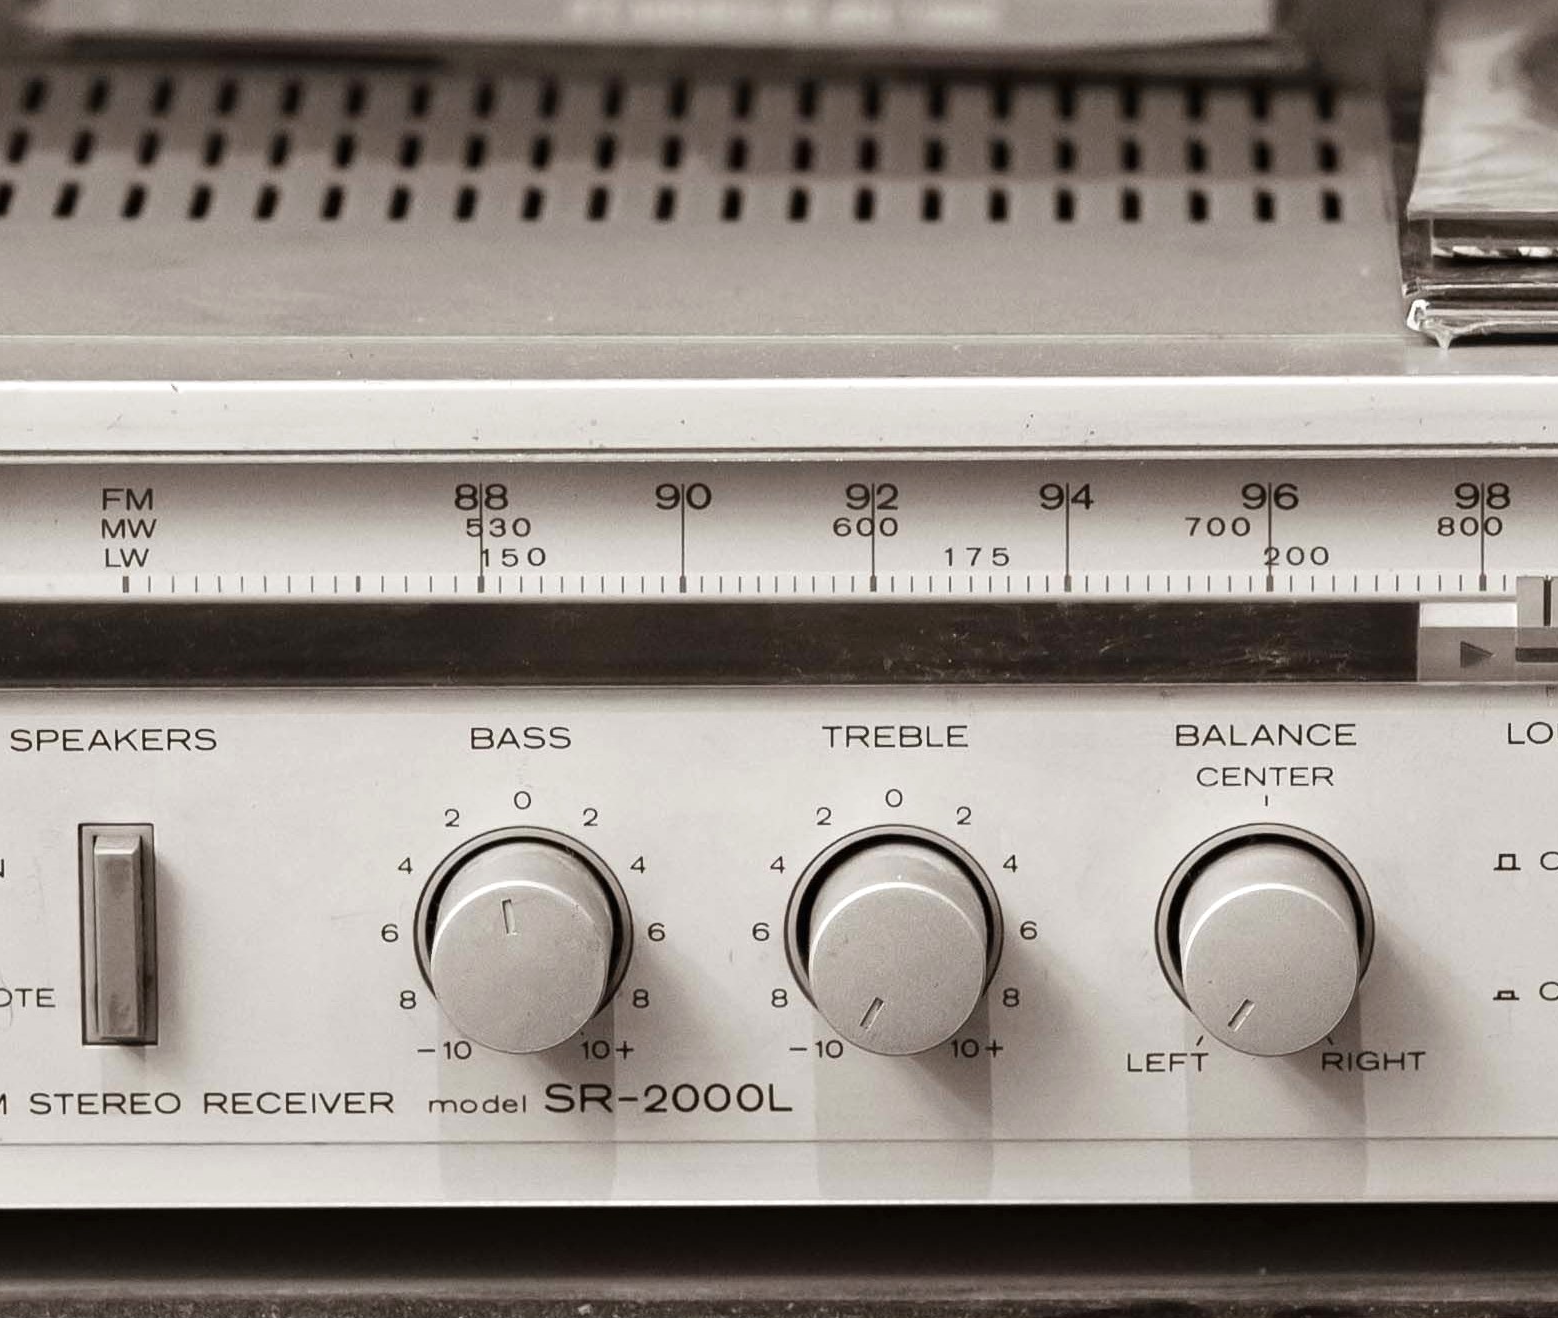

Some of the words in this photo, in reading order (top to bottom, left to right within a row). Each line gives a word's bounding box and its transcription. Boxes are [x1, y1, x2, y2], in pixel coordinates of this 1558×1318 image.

[101, 488, 154, 510] FM
[454, 484, 509, 510] 88
[654, 484, 712, 510] 90
[844, 484, 899, 510] 92
[1039, 484, 1094, 510] 94
[1241, 484, 1298, 510] 96
[1454, 484, 1510, 510] 98
[101, 518, 157, 538] MW
[466, 517, 531, 538] 530
[832, 517, 898, 537] 600
[1185, 517, 1251, 537] 700
[1437, 517, 1503, 537] 800
[104, 548, 149, 568] LW
[481, 547, 546, 568] 150
[945, 547, 1010, 568] 175
[1264, 546, 1329, 567] 200
[10, 728, 217, 752] SPEAKERS
[470, 726, 572, 750] BASS
[821, 725, 969, 748] TREBLE
[1175, 723, 1357, 747] BALANCE
[1196, 766, 1334, 787] CENTER
[513, 790, 532, 810] 0
[885, 788, 903, 808] 0
[444, 808, 460, 828] 2
[583, 807, 598, 827] 2
[816, 806, 832, 826] 2
[956, 806, 972, 826] 2
[397, 857, 413, 875] 4
[630, 856, 646, 874] 4
[770, 855, 785, 874] 4
[1002, 854, 1018, 873] 4
[381, 923, 399, 943] 6
[647, 922, 666, 942] 6
[752, 922, 770, 942] 6
[1019, 920, 1038, 941] 6
[399, 990, 417, 1010] 8
[632, 988, 650, 1009] 8
[771, 988, 788, 1008] 8
[1002, 987, 1020, 1008] 8
[1127, 1052, 1209, 1073] LEFT
[1321, 1051, 1425, 1072] RIGHT
[29, 1092, 181, 1115] STEREO
[203, 1091, 394, 1115] RECEIVER
[428, 1094, 527, 1114] model
[545, 1085, 793, 1114] SR-2000L
